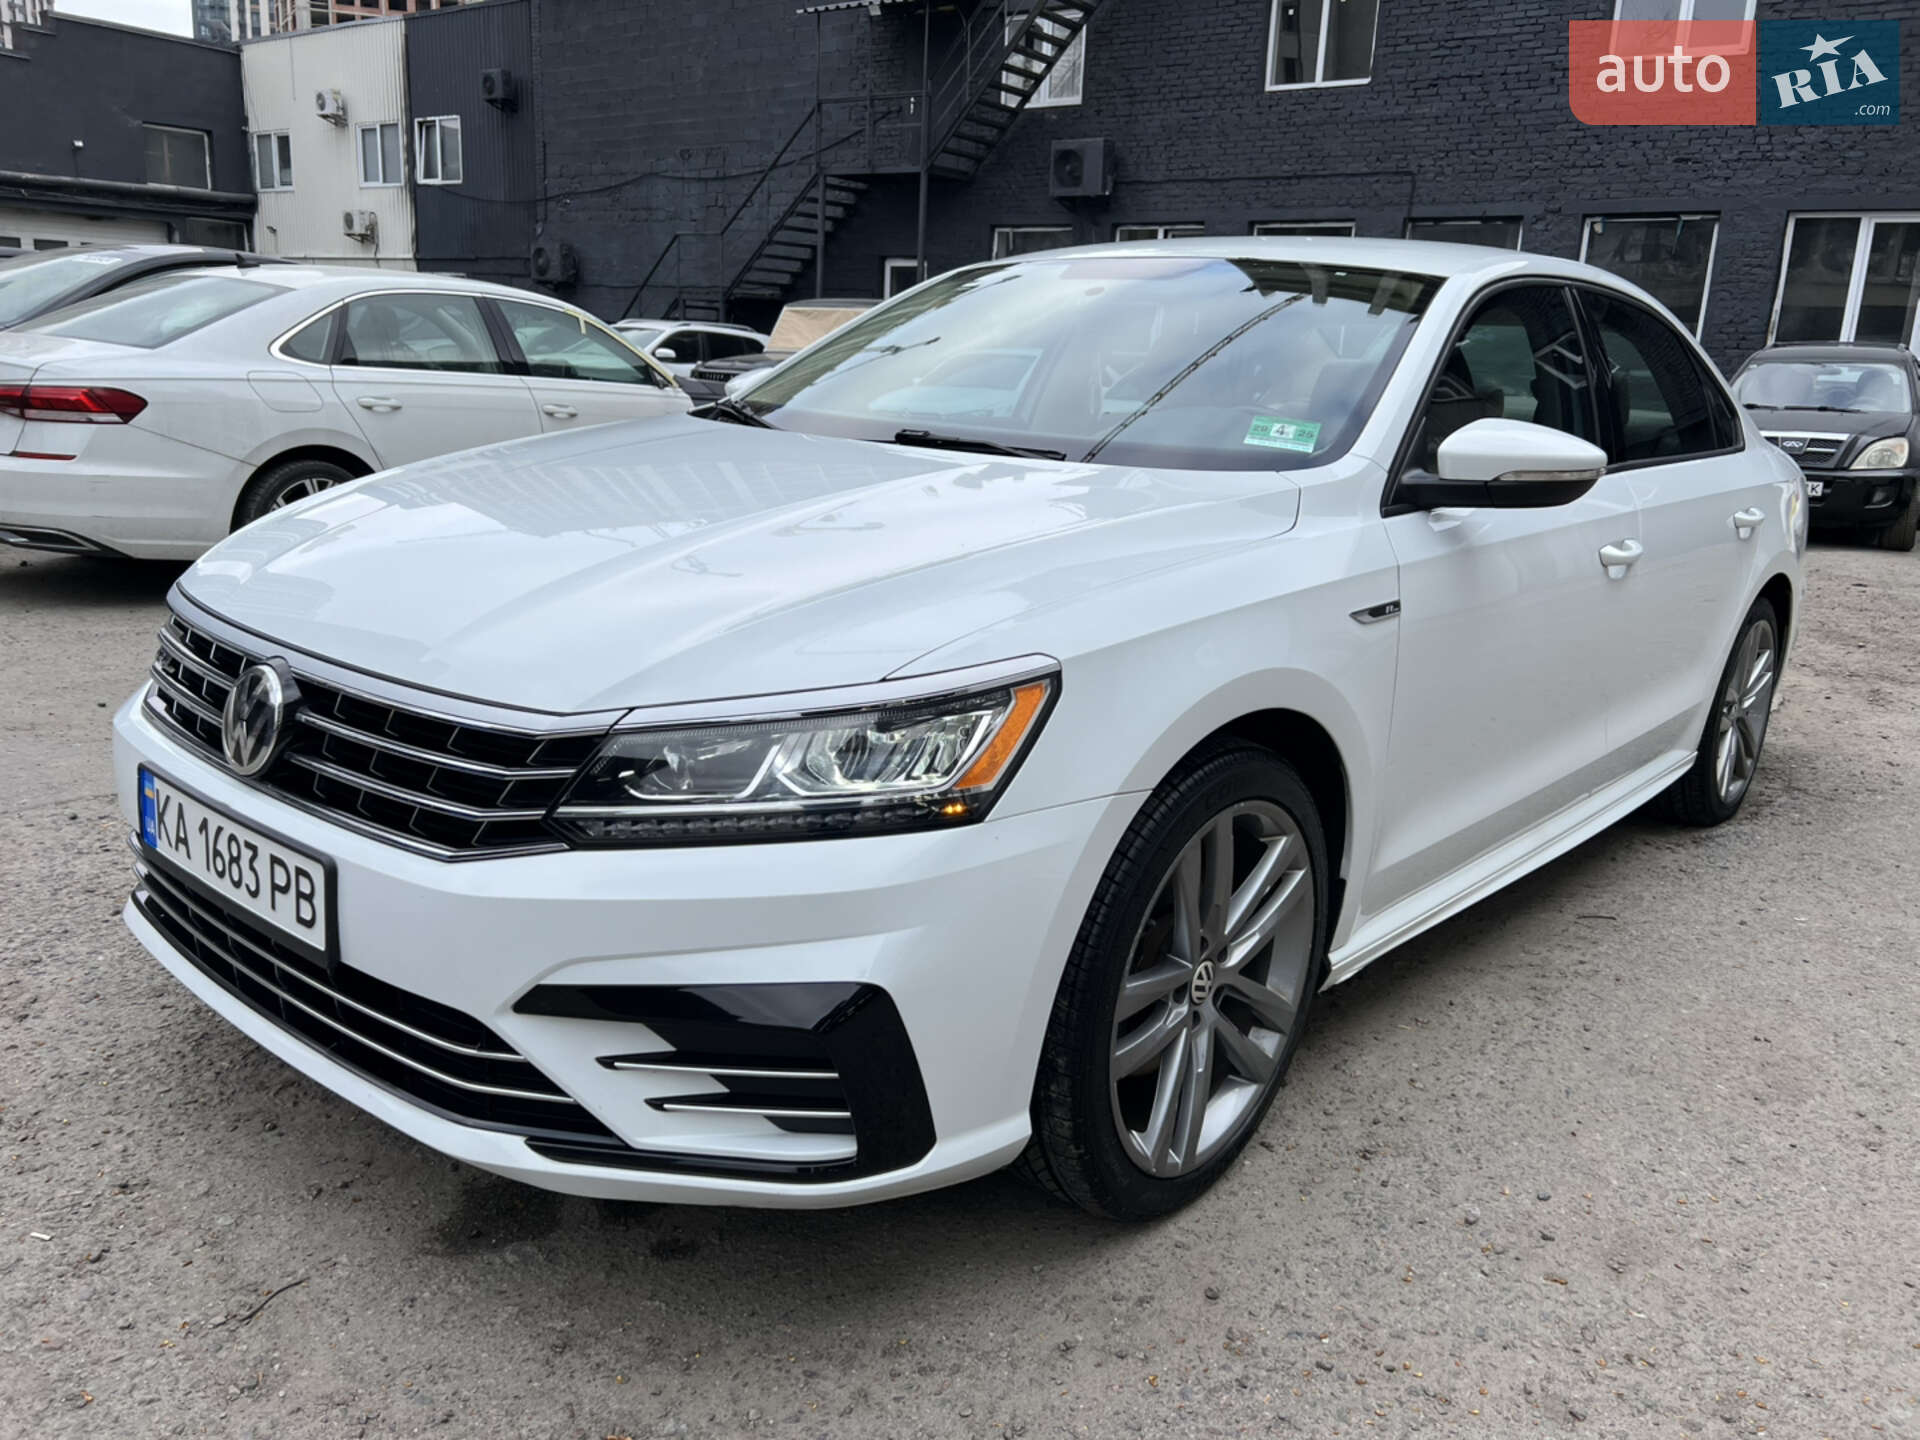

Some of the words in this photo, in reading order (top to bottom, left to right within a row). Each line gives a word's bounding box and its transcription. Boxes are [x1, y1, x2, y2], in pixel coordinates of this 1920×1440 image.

[156, 787, 192, 860] KA
[198, 816, 261, 899] 1683
[269, 853, 317, 930] PB
